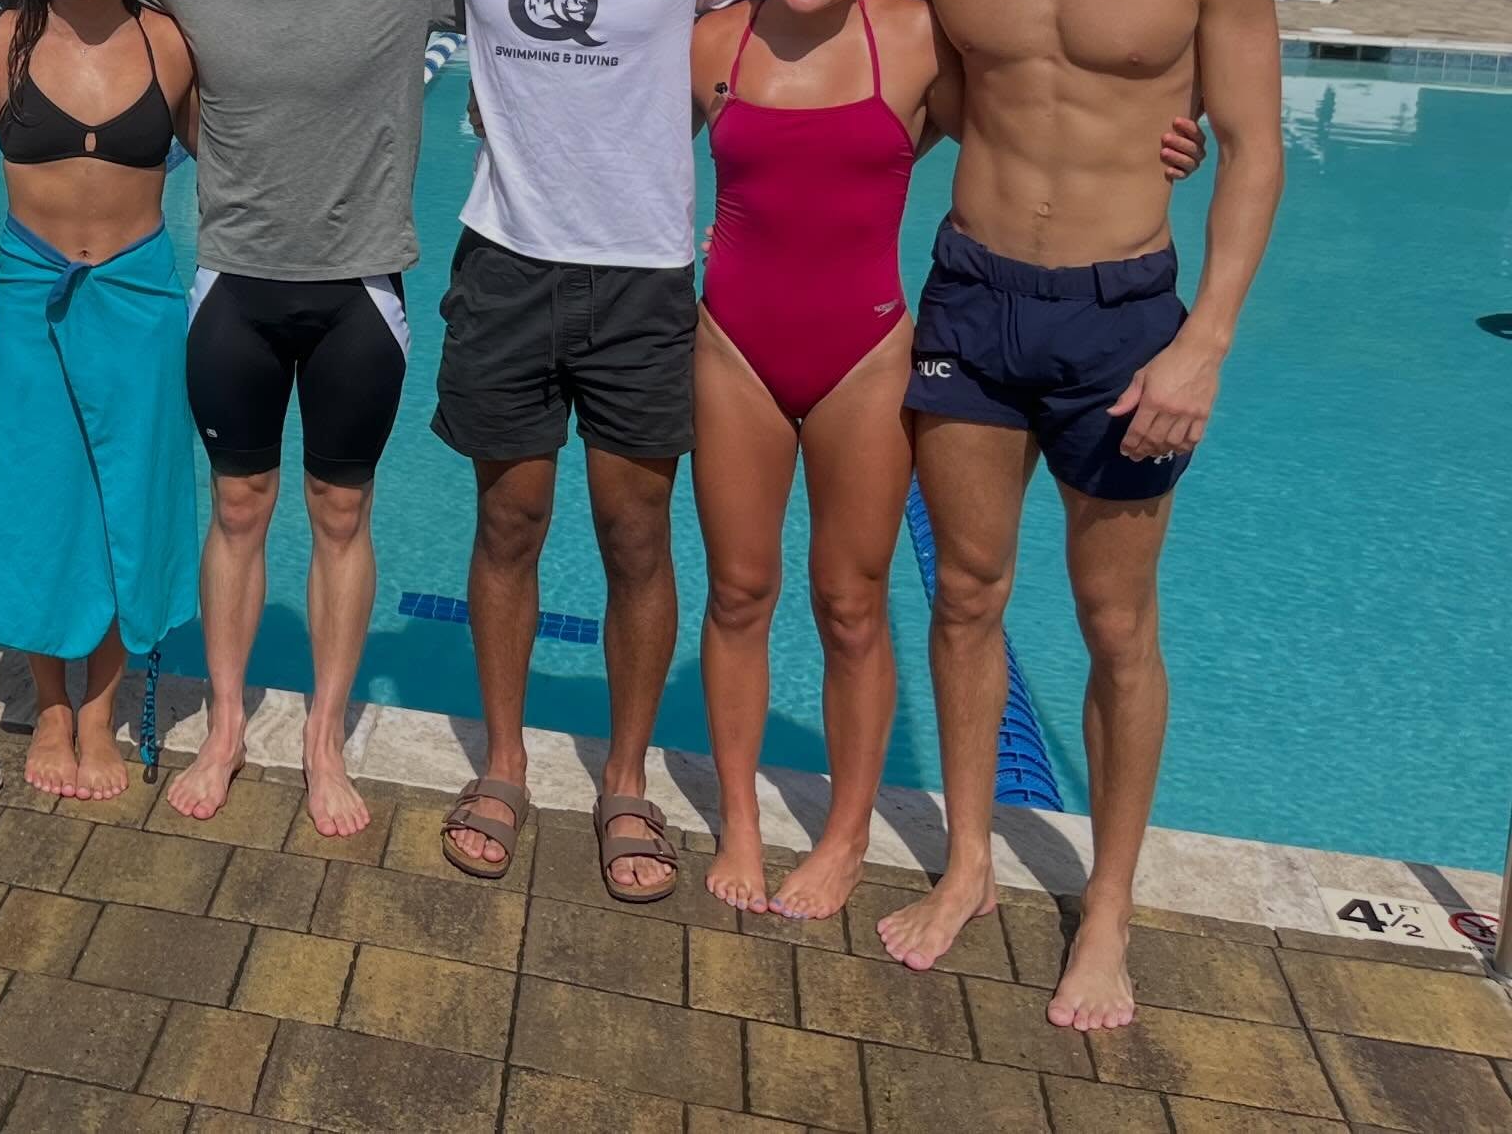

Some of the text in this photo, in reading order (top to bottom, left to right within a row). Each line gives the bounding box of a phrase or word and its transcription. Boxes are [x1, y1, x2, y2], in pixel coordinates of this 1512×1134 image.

[495, 46, 619, 67] SWIMMING & DIVING
